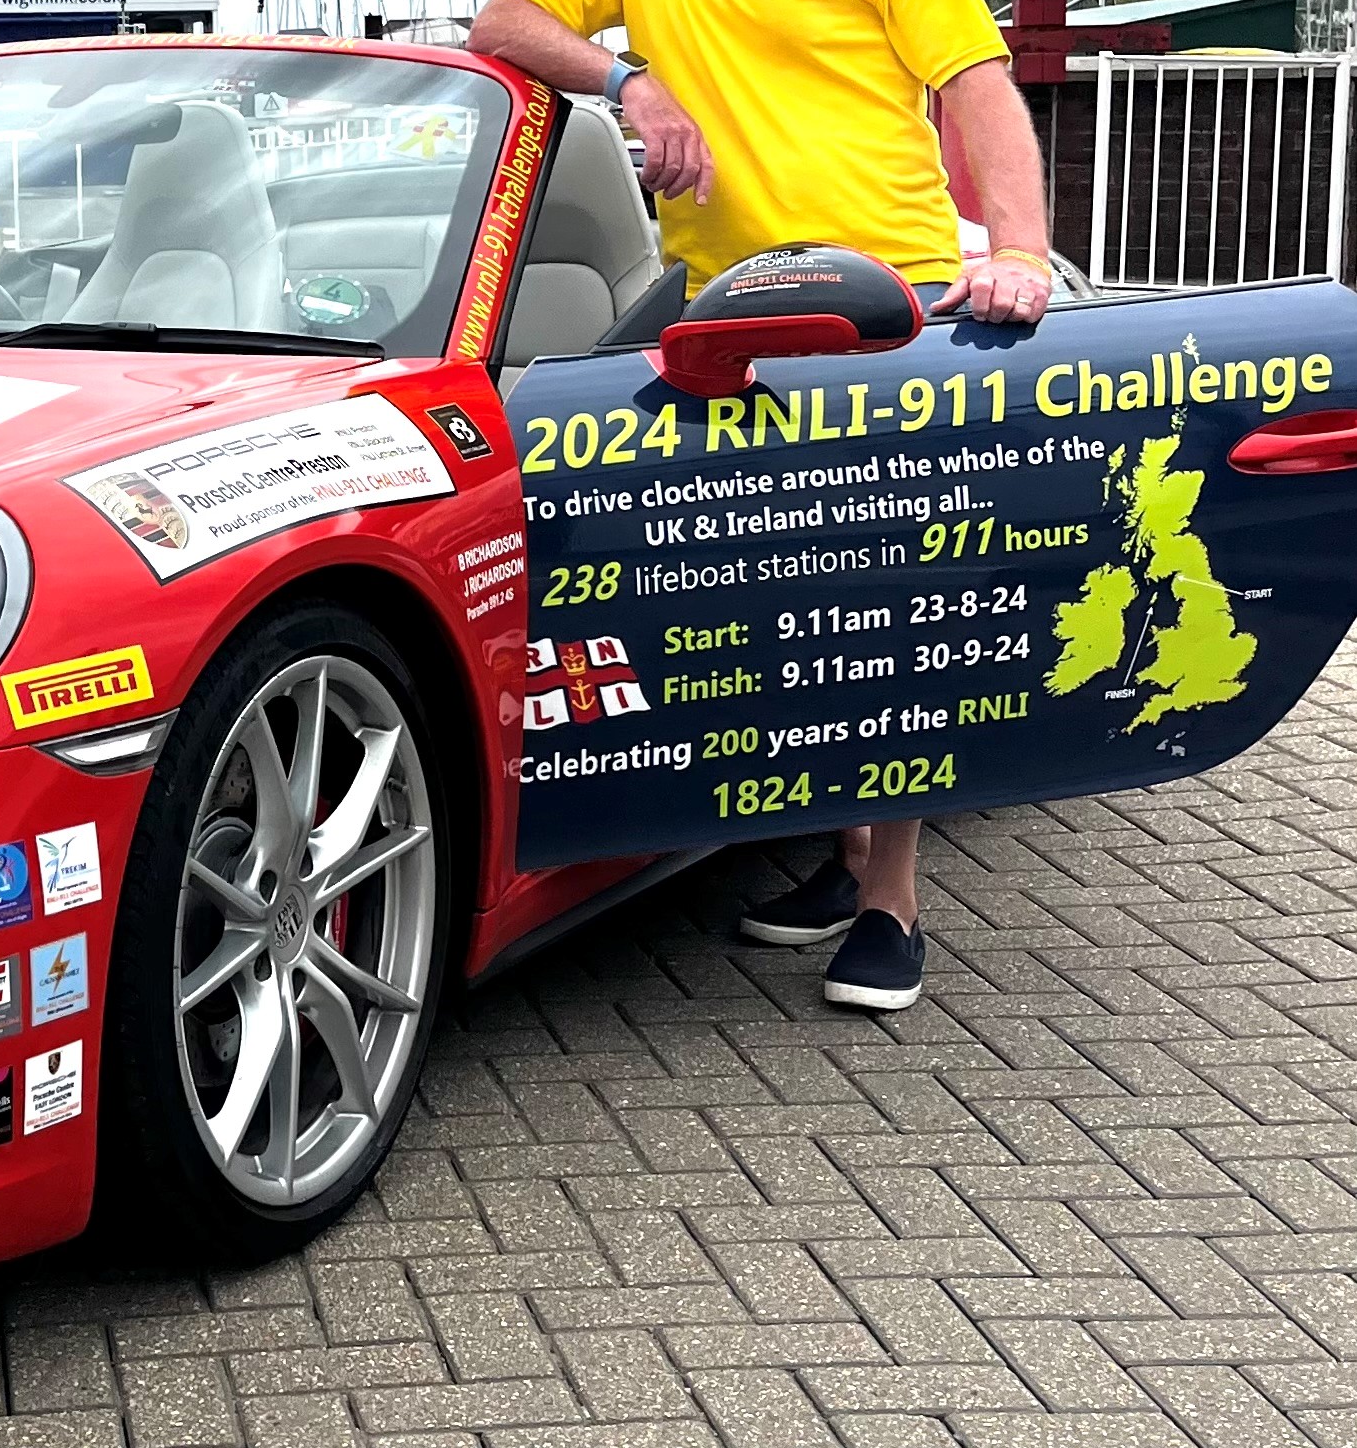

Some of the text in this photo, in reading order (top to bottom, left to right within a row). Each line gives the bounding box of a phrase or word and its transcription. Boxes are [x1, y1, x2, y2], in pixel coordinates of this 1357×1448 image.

[748, 255, 815, 270] SPORTIVA
[779, 272, 844, 283] CHALLENGE
[521, 351, 1334, 475] 2024 RNLI-911 Challenge
[143, 422, 322, 482] PORSCHE
[523, 434, 1105, 522] To drive clockwise around the whole of the
[177, 454, 351, 514] Porsche Centre Preston
[208, 466, 432, 538] Proud sponsor of the RNLI-911 CHALLENGE
[644, 485, 995, 546] UK & Ireland visiting all...
[457, 530, 524, 572] B RICHARDSON
[463, 555, 525, 598] J RICHARDSON
[541, 515, 1089, 608] 238 lifeboat stations in 911 hours
[664, 584, 1028, 654] Start: 9.11am 23-8-24
[1243, 588, 1274, 600] START
[595, 639, 618, 662] N
[663, 632, 1031, 705] Finish: 9.11am 30-9-24
[14, 658, 138, 716] PIRELLI
[533, 700, 554, 726] L
[1104, 688, 1136, 701] FINISH
[519, 691, 1030, 784] Celebrating 200 years of the RNLI
[712, 770, 813, 819] 1824
[856, 753, 957, 800] 2024
[32, 1081, 75, 1102] Porsche Centre
